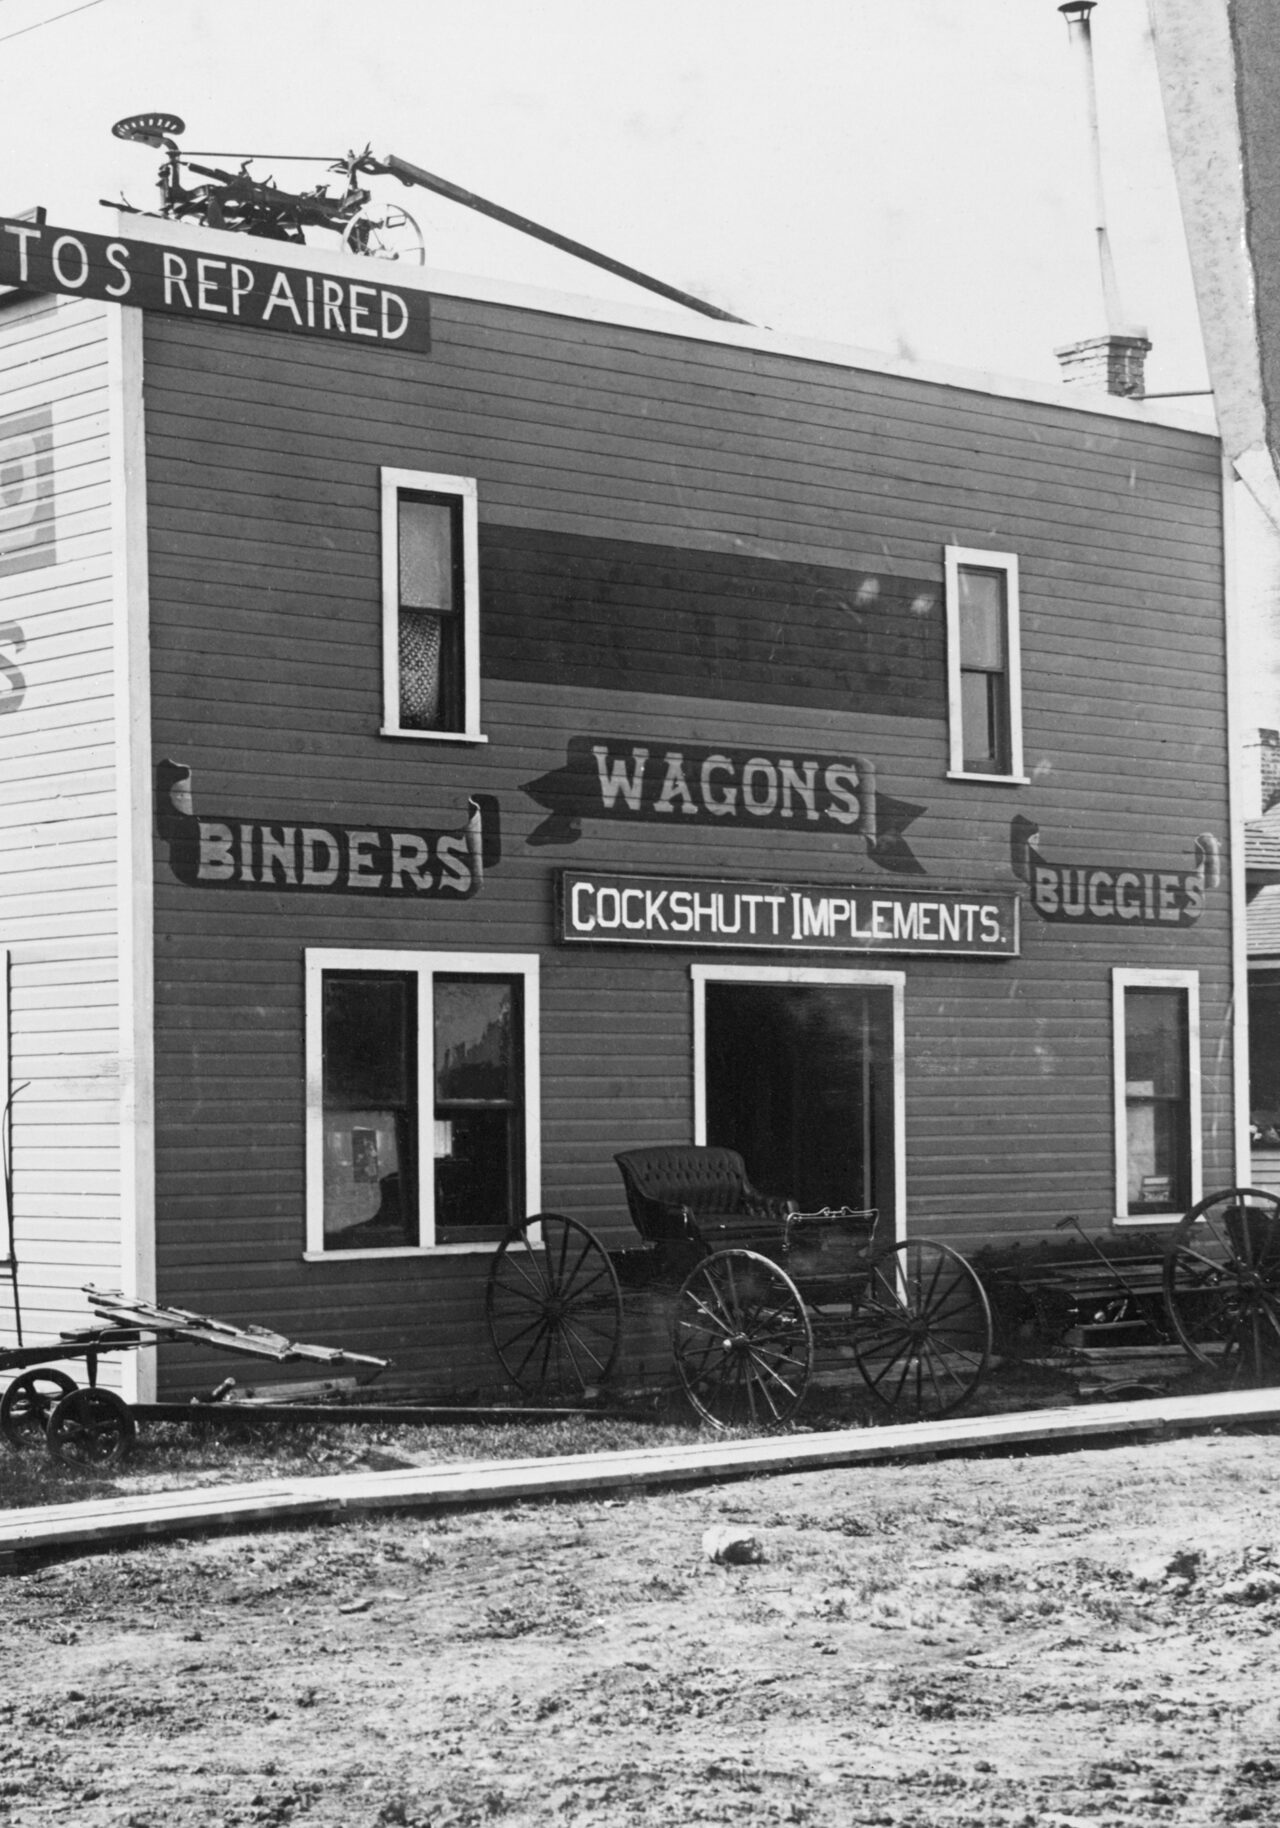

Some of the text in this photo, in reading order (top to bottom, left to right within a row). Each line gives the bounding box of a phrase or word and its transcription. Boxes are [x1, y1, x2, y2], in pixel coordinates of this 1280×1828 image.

[162, 252, 408, 340] REPAIRED
[592, 746, 862, 825] WAGONS
[196, 822, 475, 893] BINDERS
[571, 882, 1007, 944] COCKSHUTT IMPLEMENTS.
[1036, 867, 1205, 921] BUGGIES
